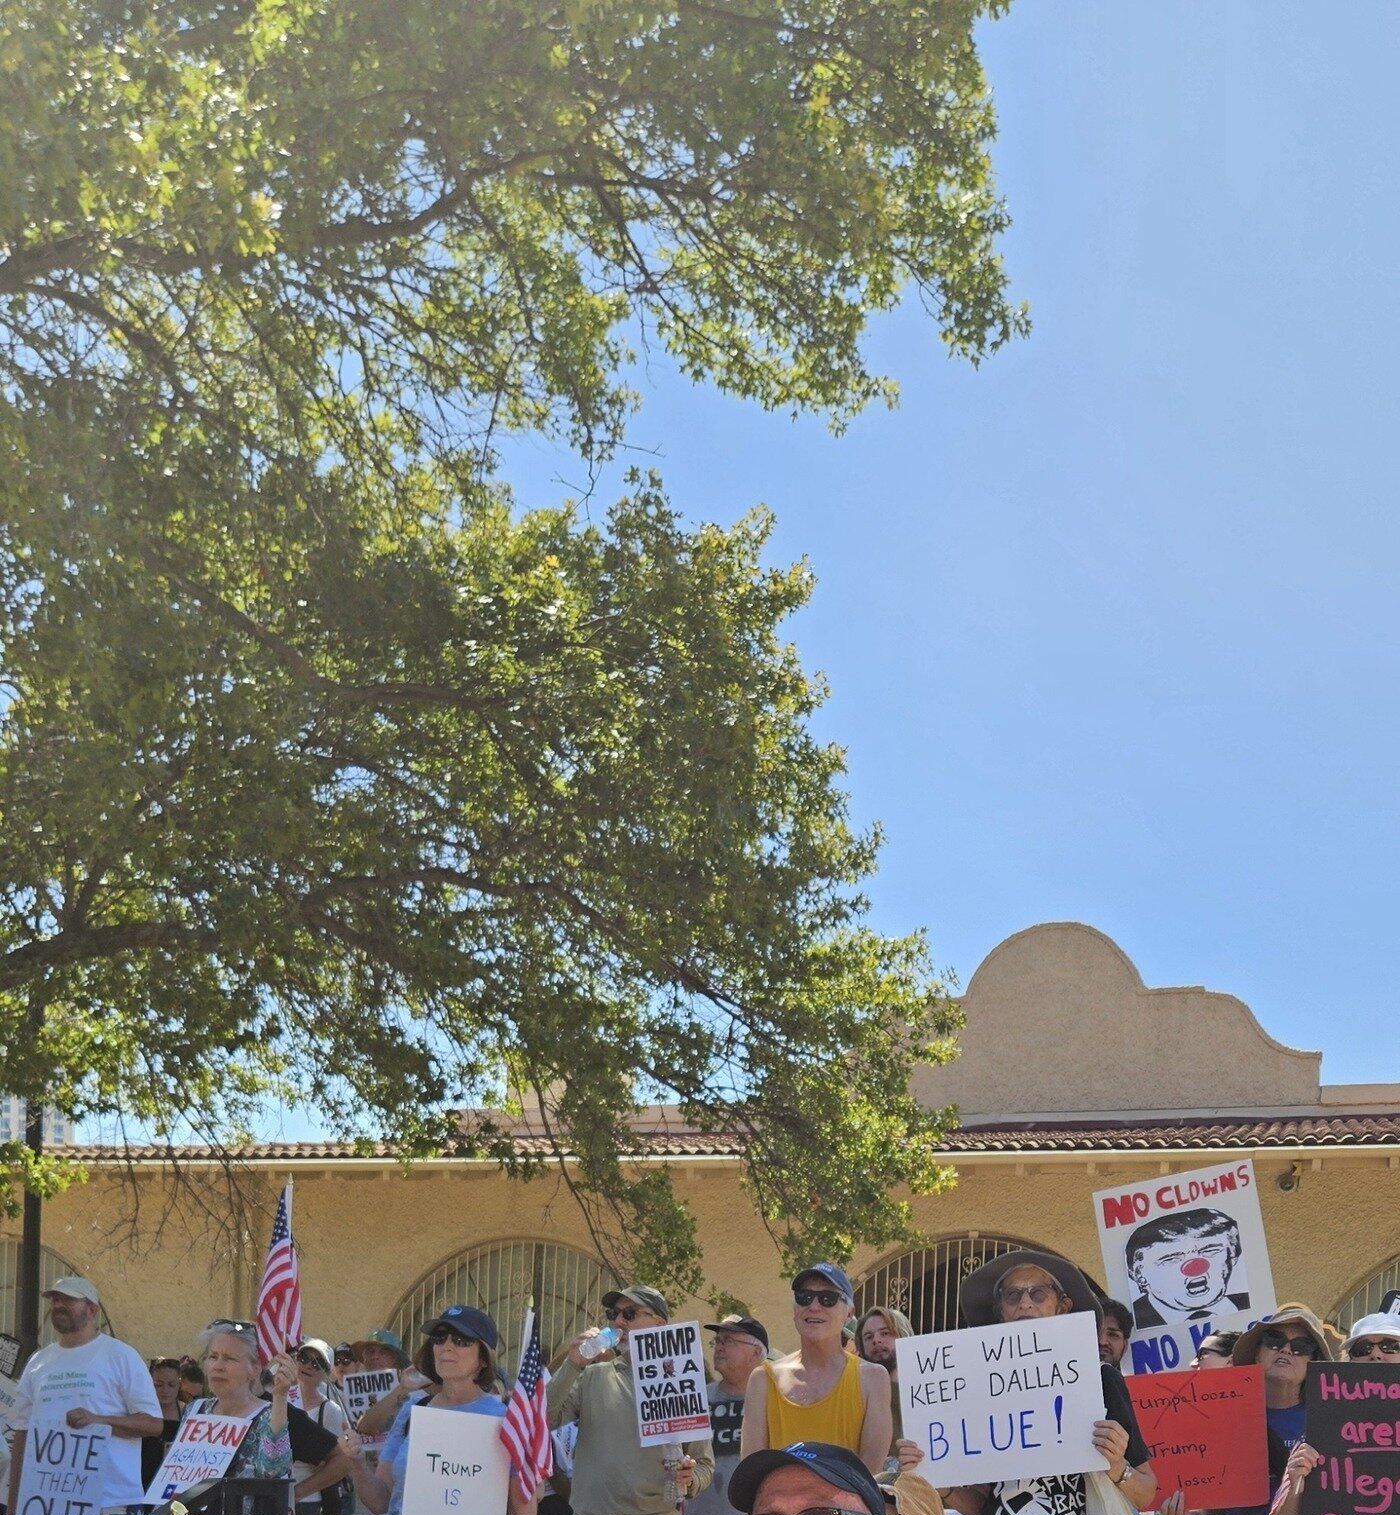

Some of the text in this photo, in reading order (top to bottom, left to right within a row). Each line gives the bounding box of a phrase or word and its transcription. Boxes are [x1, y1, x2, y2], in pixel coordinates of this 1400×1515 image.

[1101, 1165, 1250, 1229] NO CLOWNS
[634, 1326, 696, 1361] TRUMP
[916, 1332, 1052, 1374] WE WILL
[1130, 1334, 1180, 1375] NO
[638, 1359, 700, 1380] IS A
[346, 1372, 394, 1394] TRUMP
[641, 1379, 696, 1399] WAR
[910, 1360, 1080, 1408] KEEP DALLAS
[349, 1397, 365, 1407] IS
[640, 1392, 707, 1422] CRIMINAL
[179, 1418, 248, 1447] TEXAN
[929, 1395, 1063, 1461] BLUE!
[33, 1428, 106, 1472] VOTE
[170, 1449, 232, 1466] AGAINST
[1149, 1442, 1207, 1458] Trump
[37, 1470, 89, 1495] THEM
[161, 1465, 219, 1482] TRUMP
[1177, 1465, 1226, 1488] loser!
[445, 1488, 462, 1506] IS
